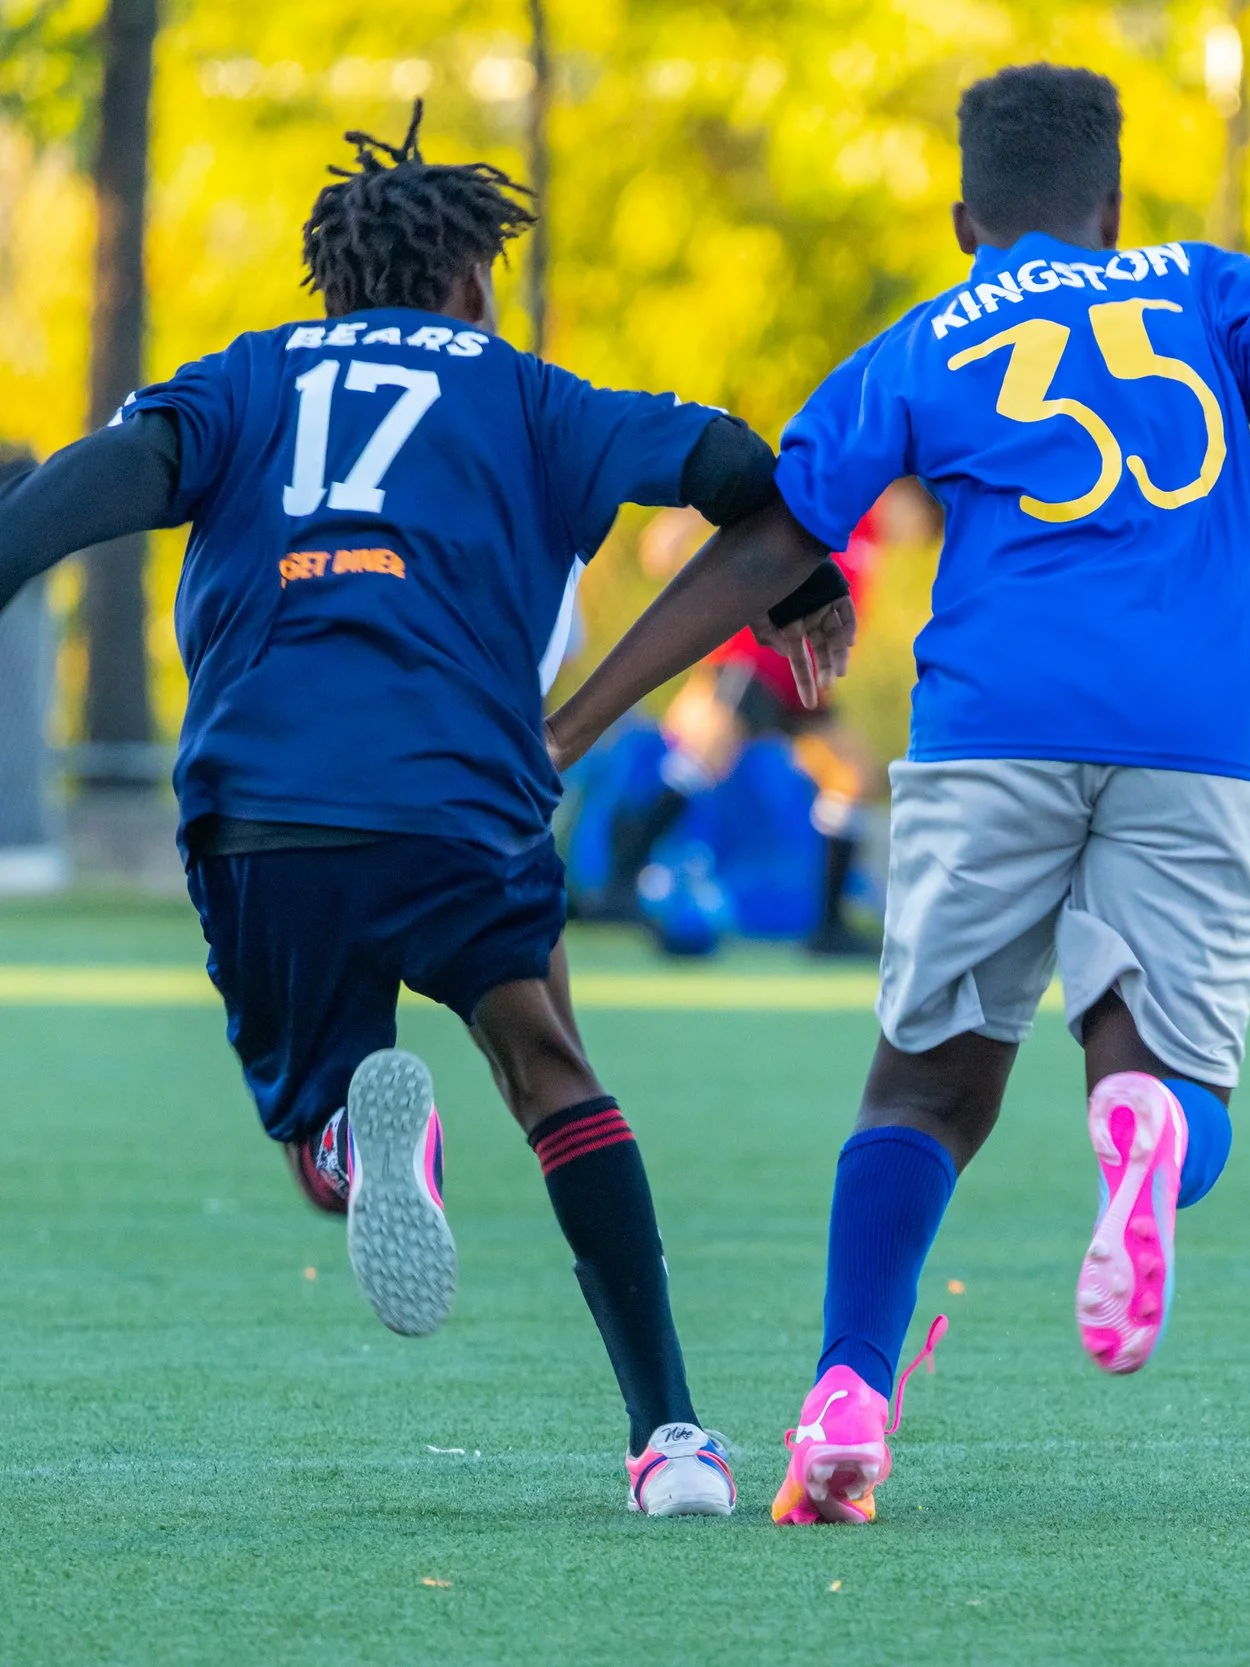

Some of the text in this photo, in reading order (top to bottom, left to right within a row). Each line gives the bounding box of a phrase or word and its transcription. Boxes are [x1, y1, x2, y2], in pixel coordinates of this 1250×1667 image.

[285, 321, 490, 357] BEARS
[931, 243, 1191, 340] KINGSTON
[283, 359, 442, 517] 17
[948, 297, 1227, 523] 35
[661, 1426, 694, 1443] Nike
